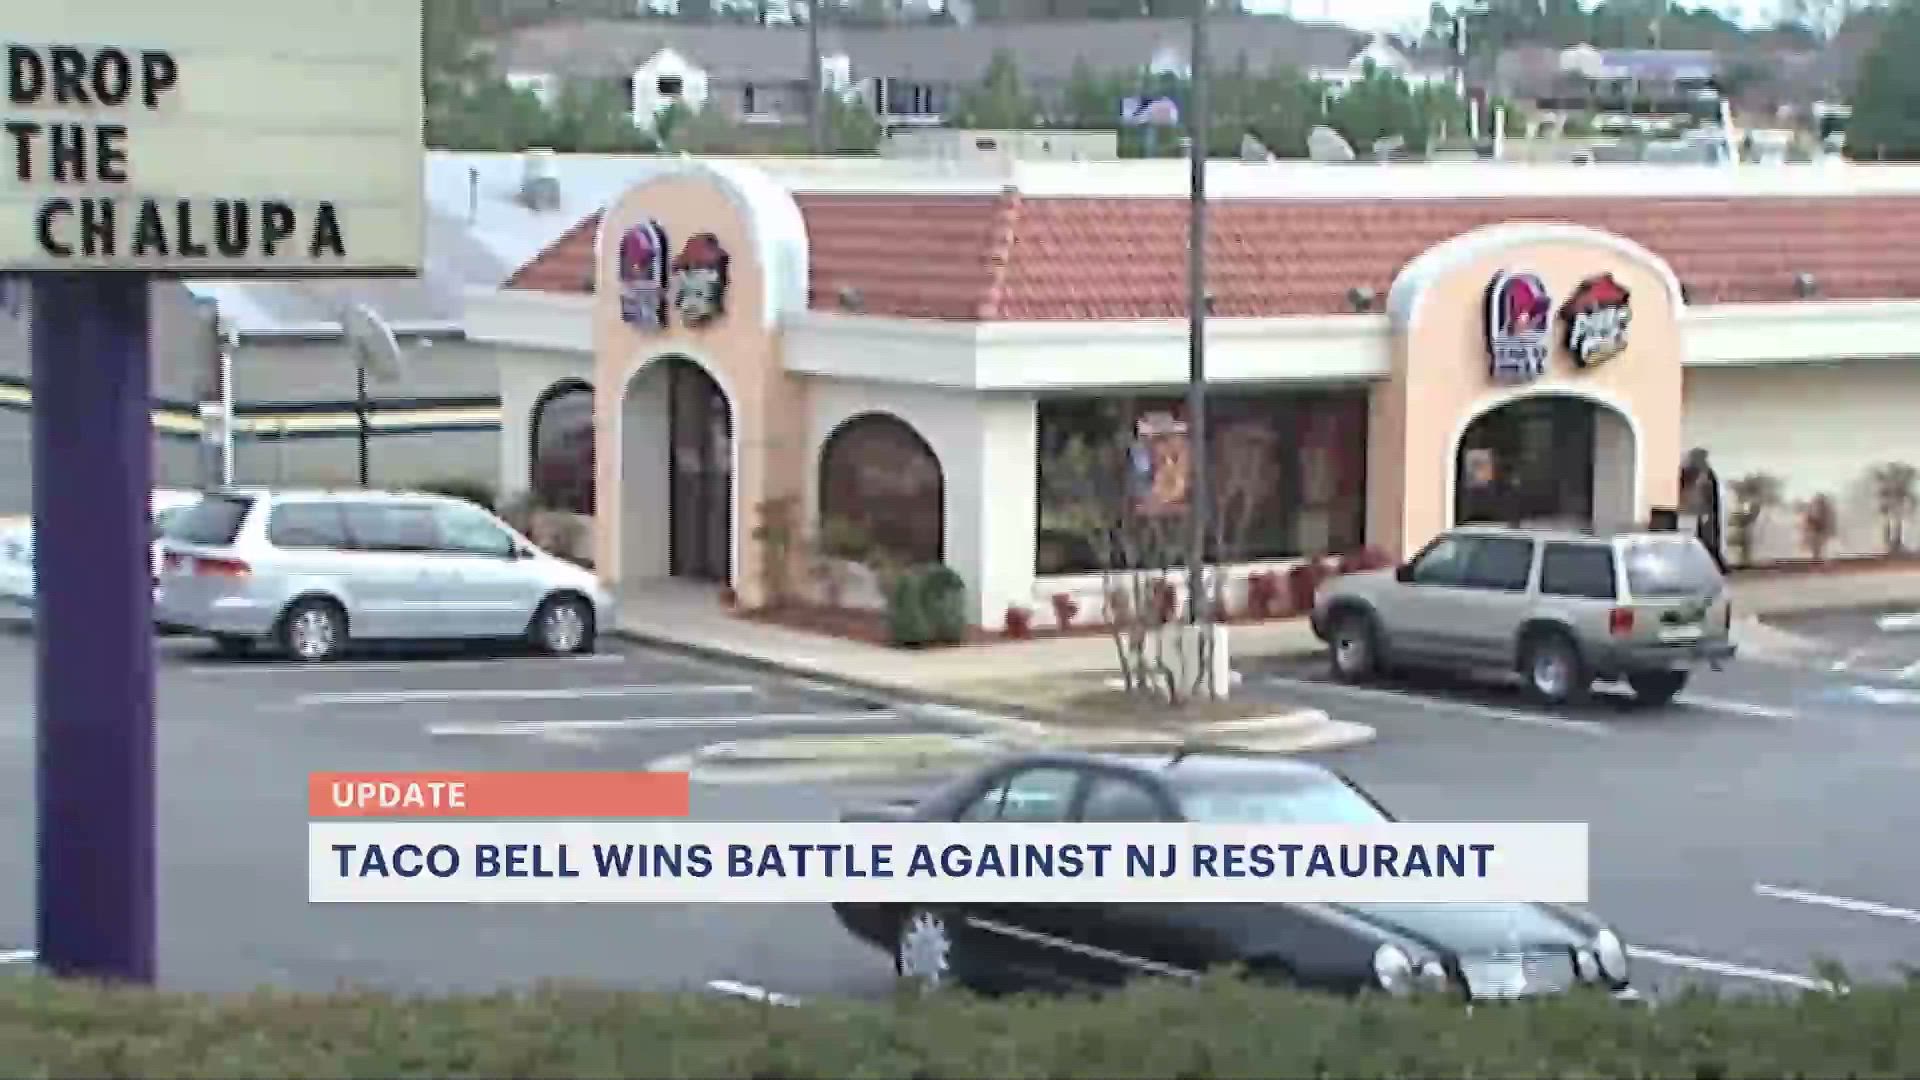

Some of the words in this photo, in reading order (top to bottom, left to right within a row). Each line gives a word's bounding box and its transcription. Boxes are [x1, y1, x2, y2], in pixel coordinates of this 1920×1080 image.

[6, 45, 179, 108] DROP
[4, 122, 129, 184] THE
[36, 198, 347, 258] CHALUPA
